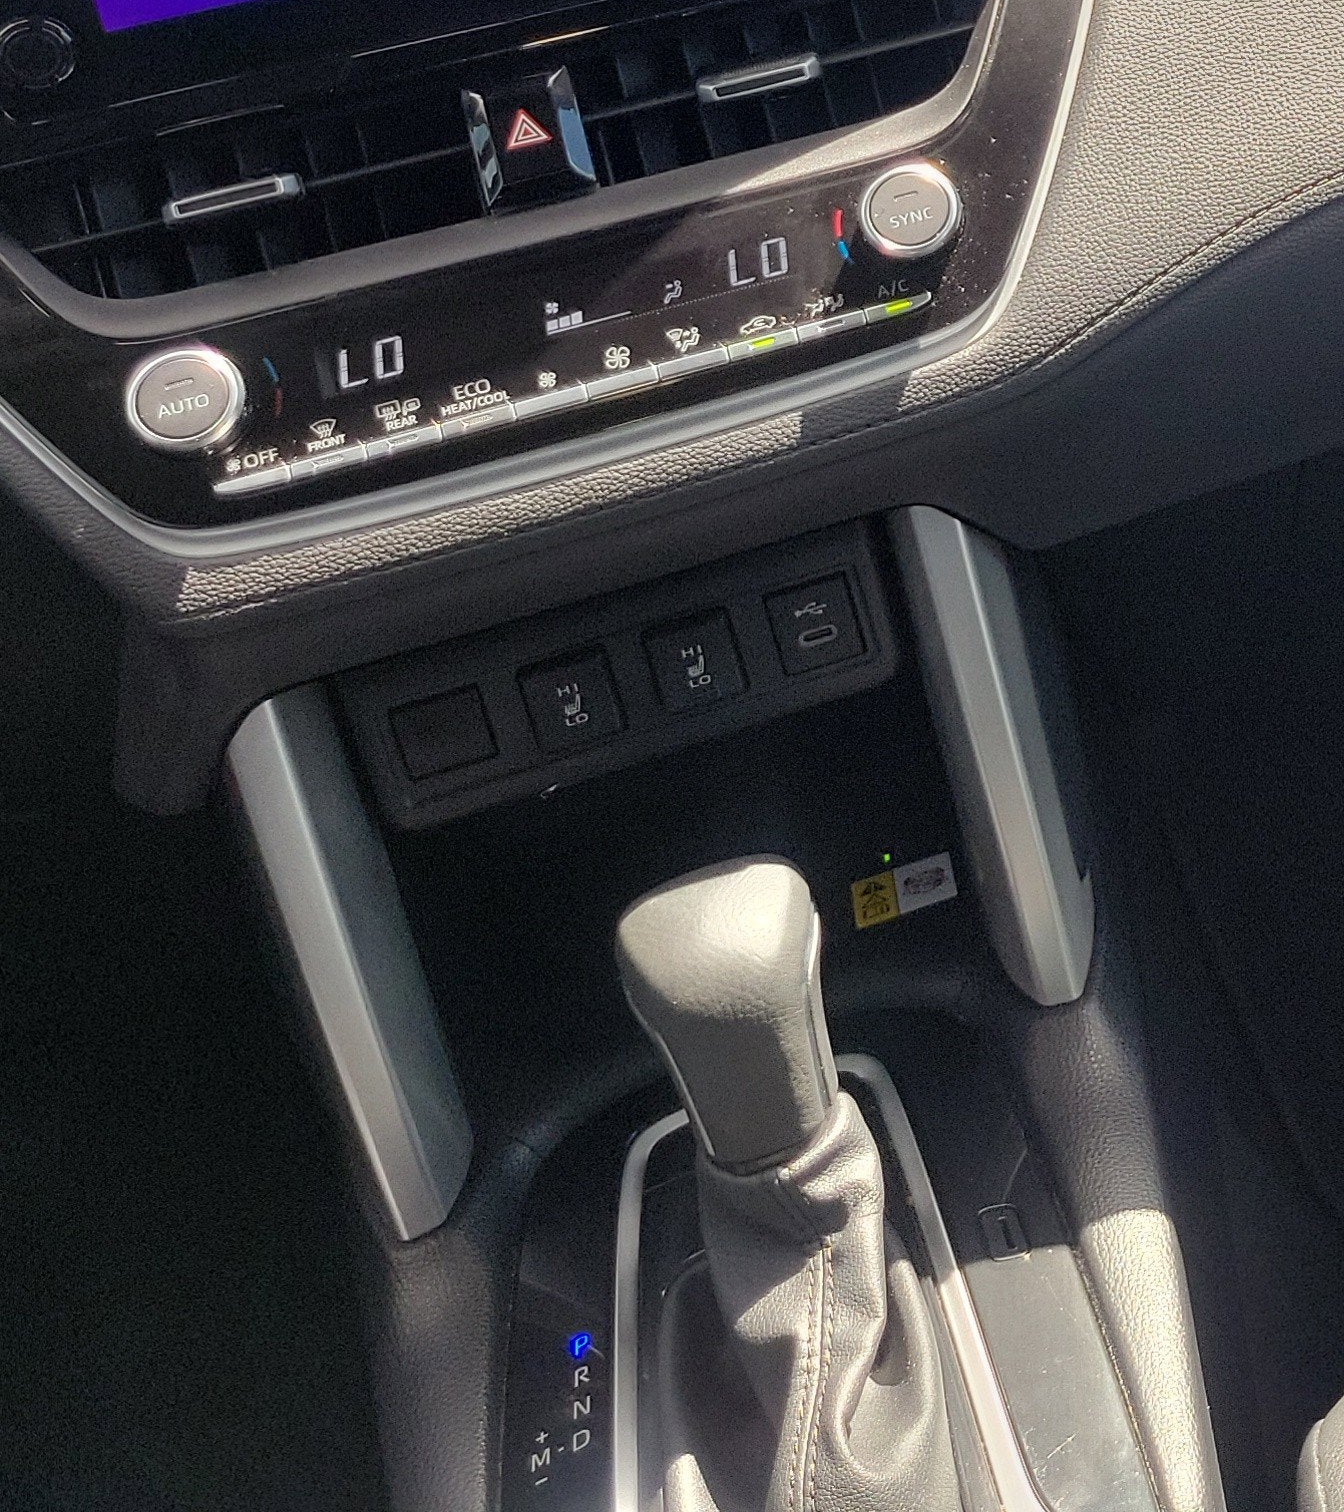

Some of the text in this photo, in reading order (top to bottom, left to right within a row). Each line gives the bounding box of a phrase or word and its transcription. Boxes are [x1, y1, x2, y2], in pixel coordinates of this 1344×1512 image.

[889, 206, 934, 229] SYNC
[728, 236, 789, 287] LO
[877, 279, 911, 299] A/C
[338, 335, 404, 389] LO
[453, 378, 491, 401] ECO
[157, 393, 210, 419] AUTO
[440, 390, 511, 417] HEAT/COOL
[386, 414, 418, 432] REAR
[307, 433, 347, 453] FRONT
[242, 447, 280, 469] OFF
[681, 644, 703, 659] HI
[557, 683, 579, 697] HI
[688, 674, 712, 689] LO
[565, 713, 589, 727] LO
[574, 1335, 589, 1357] P
[574, 1365, 591, 1388] R
[573, 1396, 591, 1420] N
[531, 1429, 591, 1473] M D
